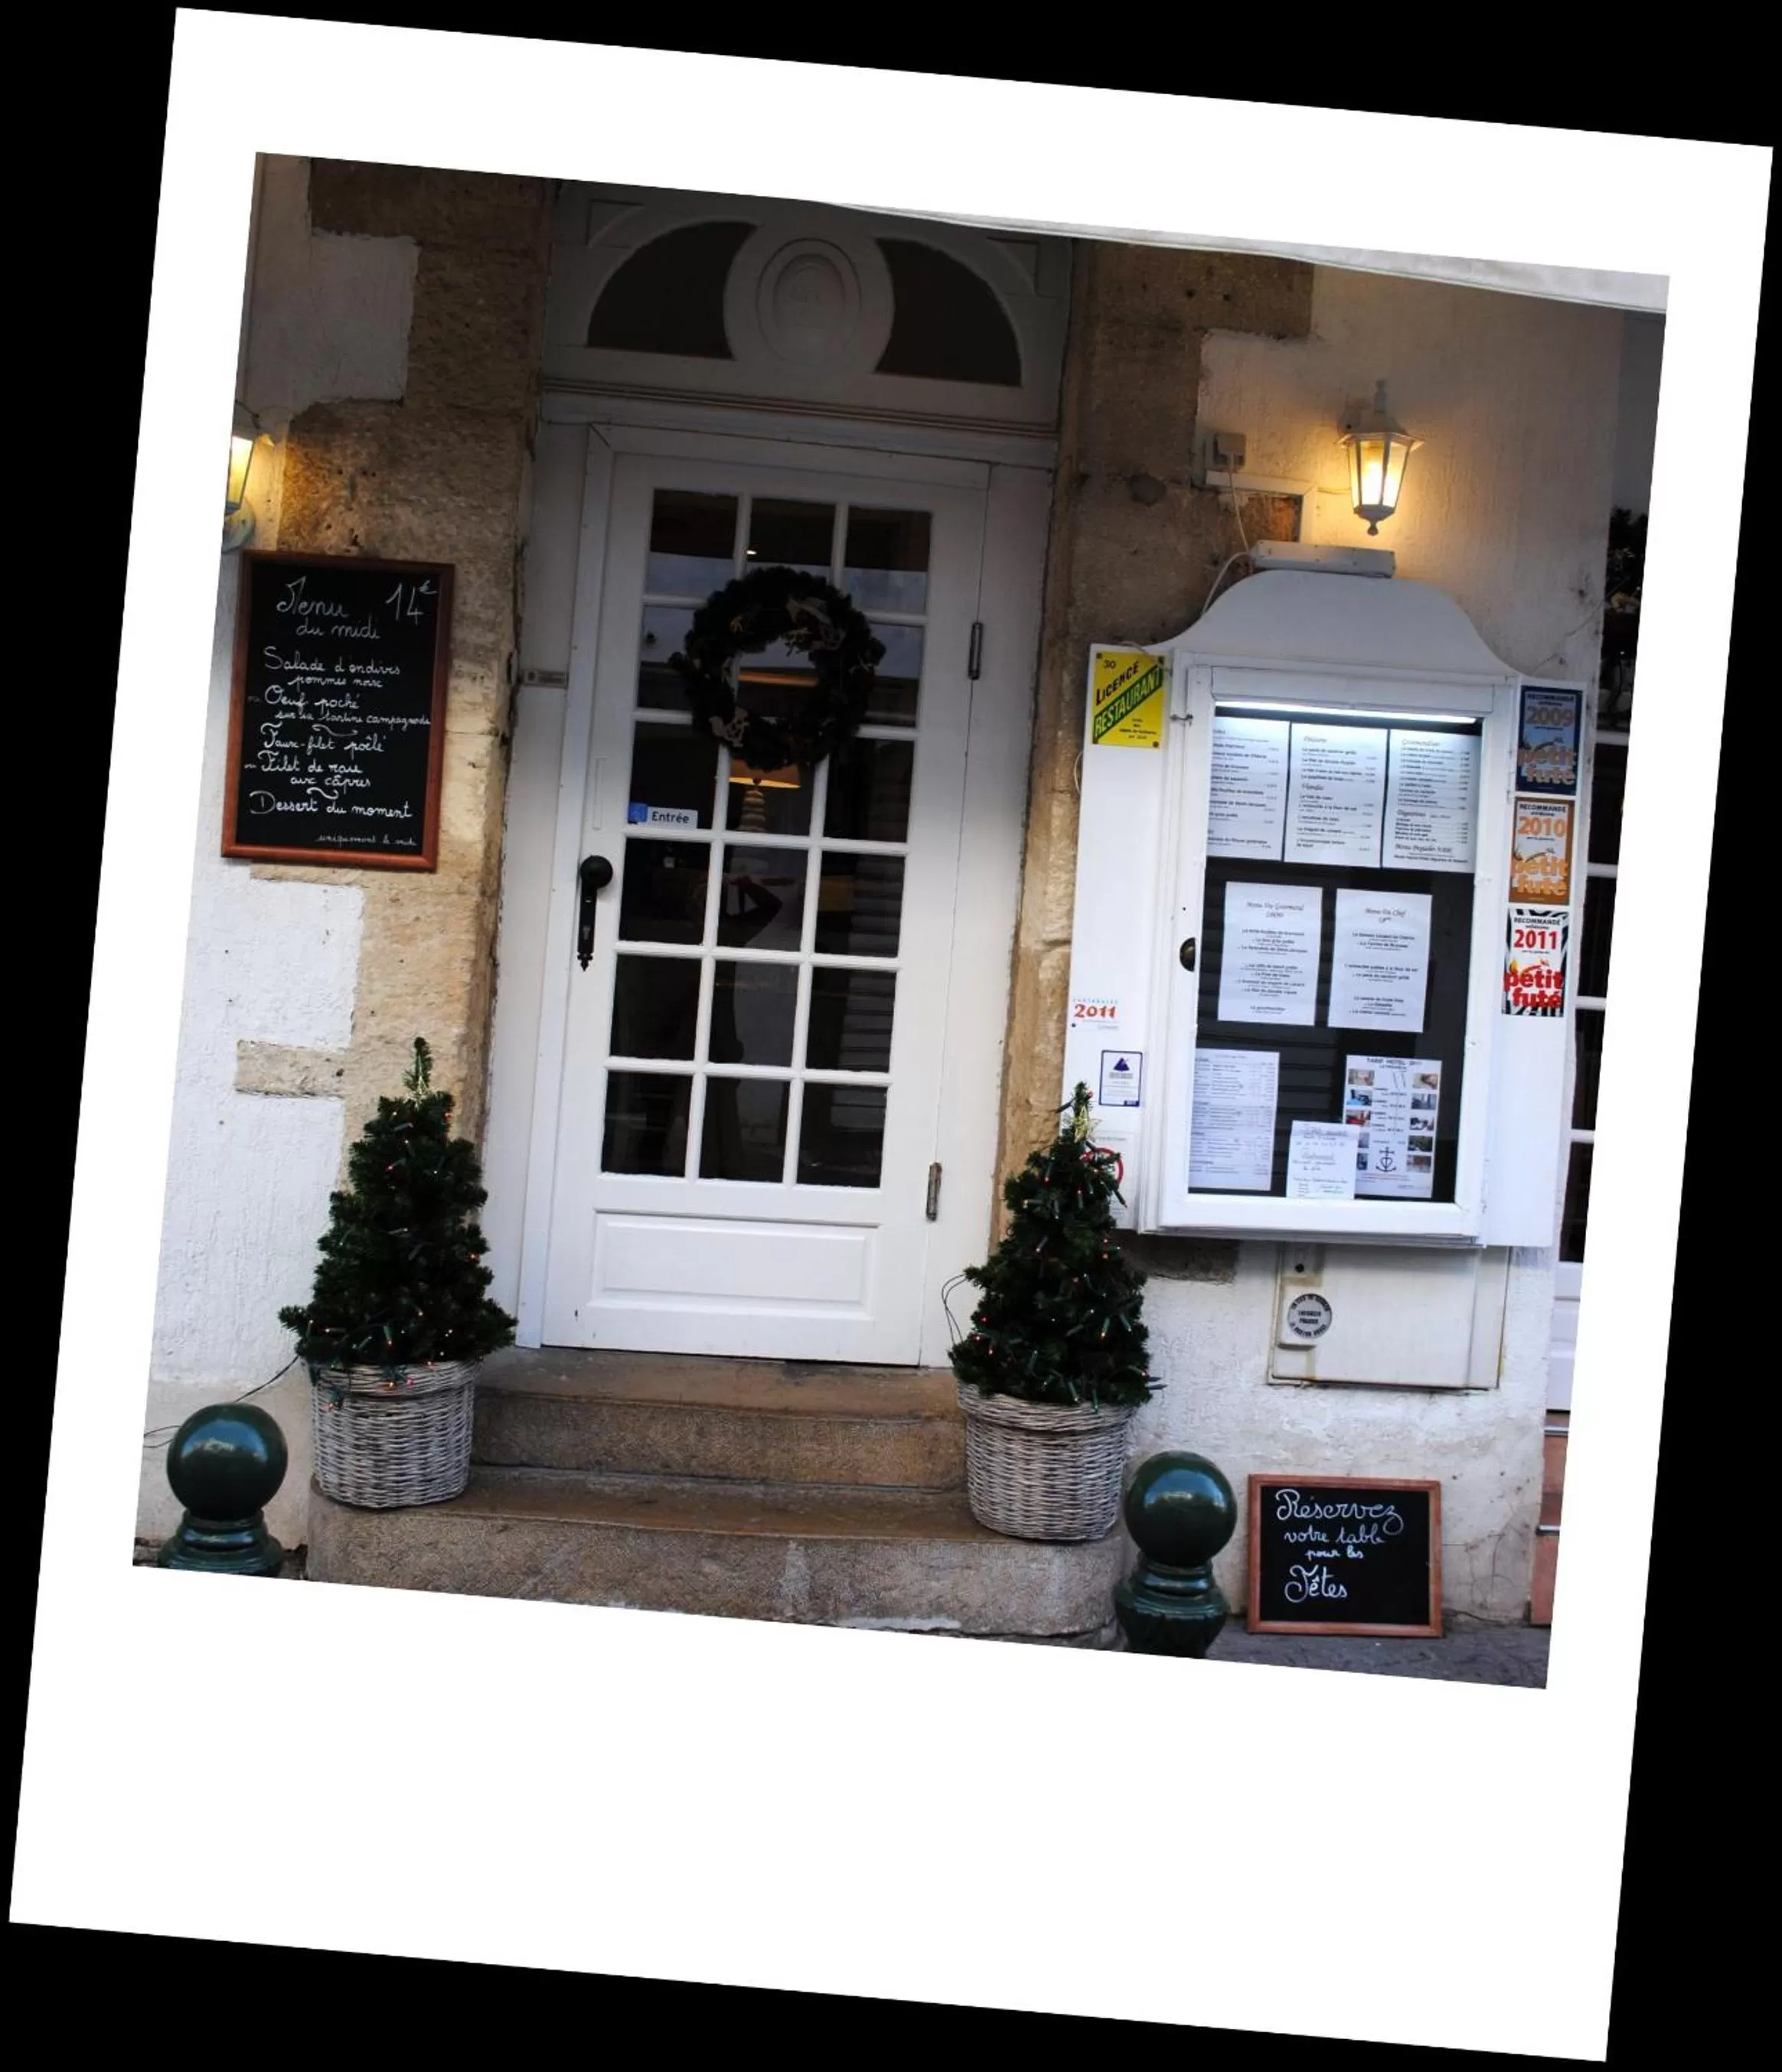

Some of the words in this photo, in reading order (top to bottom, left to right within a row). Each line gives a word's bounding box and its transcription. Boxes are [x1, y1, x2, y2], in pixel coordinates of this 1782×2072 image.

[276, 576, 349, 618] Menu
[296, 618, 325, 638] du
[331, 614, 382, 640] midi
[264, 646, 325, 671] Salade
[1103, 660, 1117, 670] 30
[1096, 661, 1140, 706] LICENCE
[1095, 665, 1162, 739] RESTAURANT
[1526, 705, 1575, 727] 2009
[308, 757, 323, 773] de
[249, 789, 318, 814] Dessert
[327, 798, 347, 815] du
[352, 801, 413, 818] moment
[651, 811, 690, 824] Entrée
[1518, 816, 1566, 837] 2010
[1513, 928, 1558, 949] 2011
[1503, 969, 1563, 992] petit
[1512, 987, 1562, 1009] futé
[1073, 1003, 1116, 1019] 2011
[1274, 1488, 1404, 1535] Réservez
[1284, 1524, 1330, 1544] votre
[1336, 1523, 1387, 1545] table
[1304, 1548, 1341, 1561] pour
[1346, 1544, 1365, 1559] les
[1284, 1565, 1348, 1604] Fêtes
